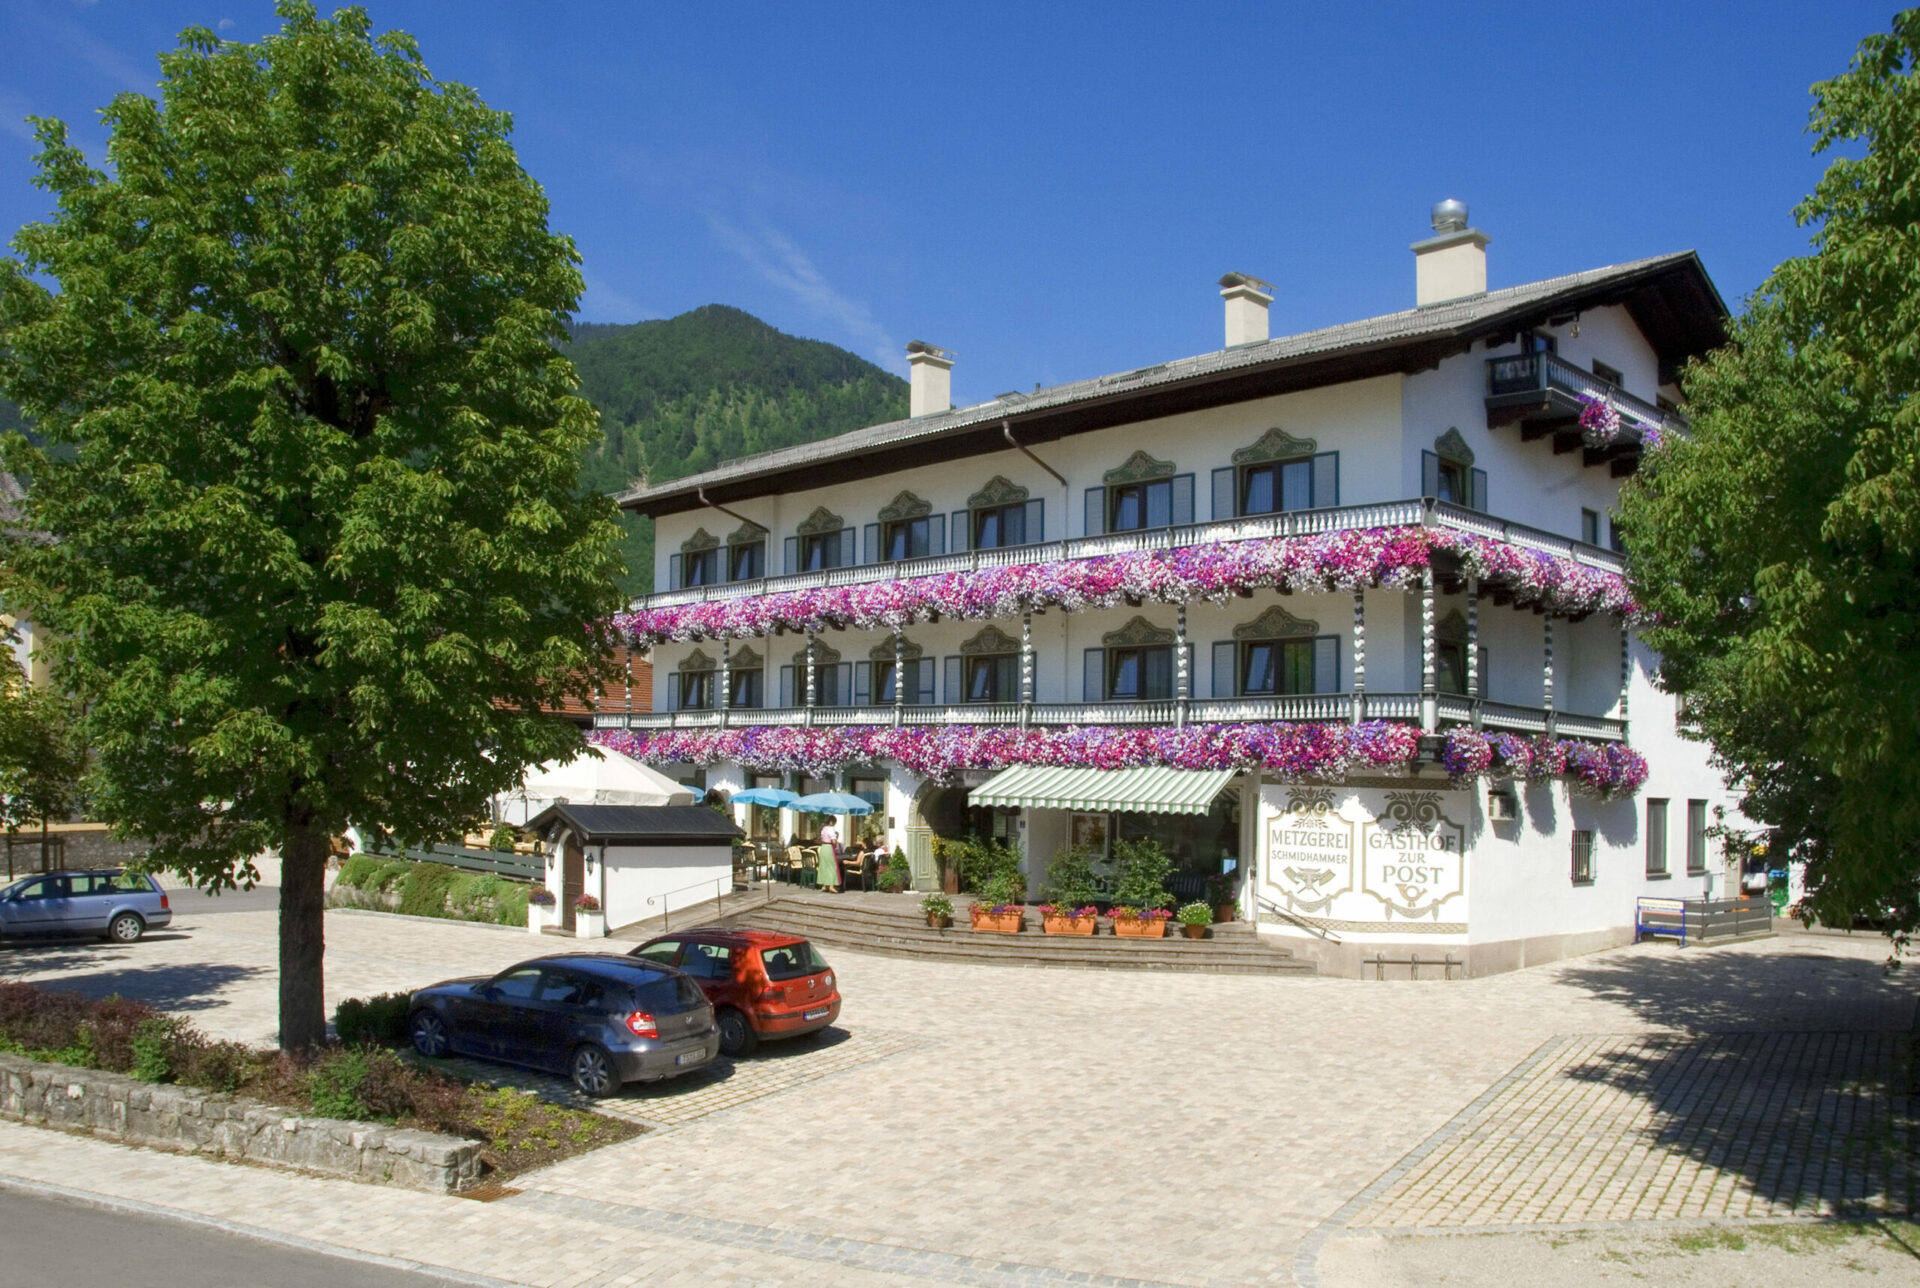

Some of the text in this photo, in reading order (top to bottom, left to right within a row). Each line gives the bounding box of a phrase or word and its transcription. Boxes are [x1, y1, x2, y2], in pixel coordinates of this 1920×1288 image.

[1272, 829, 1348, 849] METZGEREI
[1369, 833, 1456, 851] GASTHOF
[1272, 850, 1348, 864] SCHMIDHAMMER
[1398, 852, 1426, 863] ZUR
[1383, 865, 1444, 884] POST
